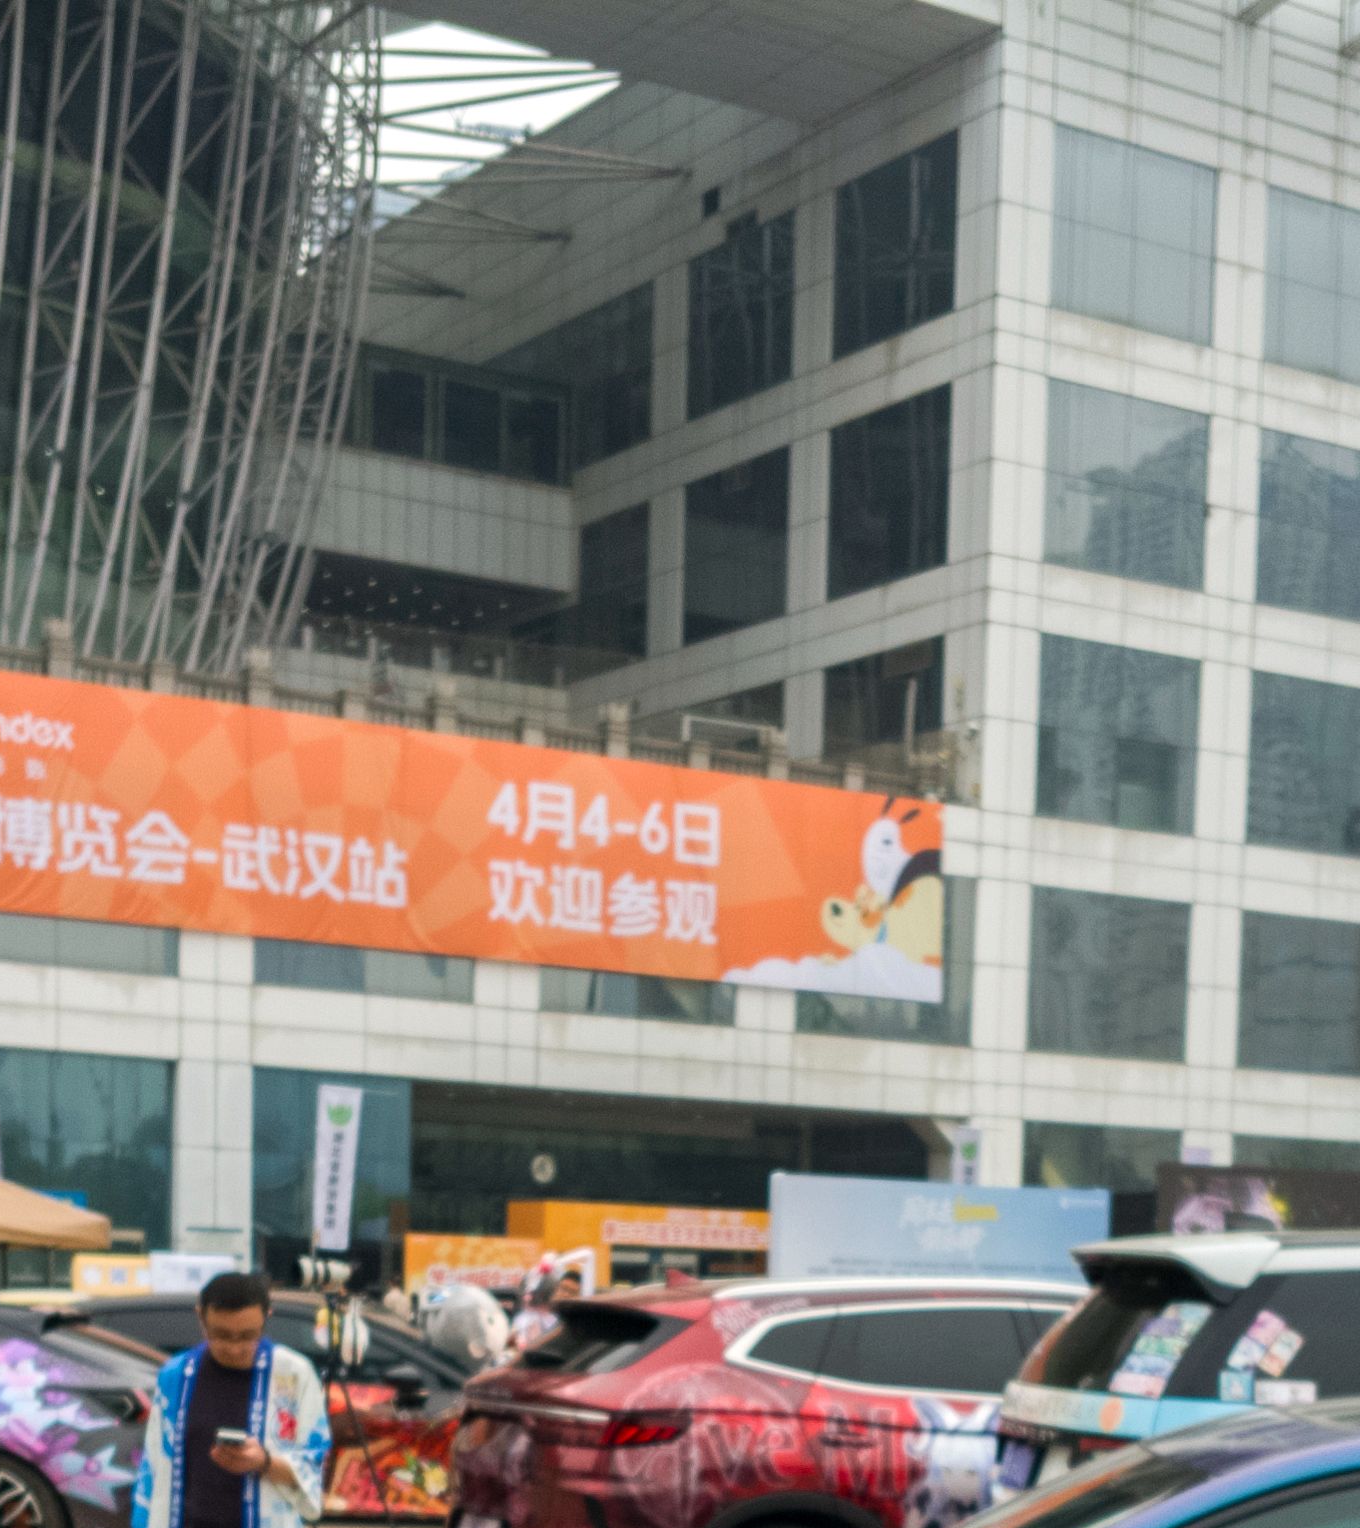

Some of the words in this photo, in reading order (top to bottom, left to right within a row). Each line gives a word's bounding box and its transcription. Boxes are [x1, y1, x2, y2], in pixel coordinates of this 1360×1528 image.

[487, 780, 722, 868] 4月4-6日
[488, 857, 718, 945] 欢迎参观
